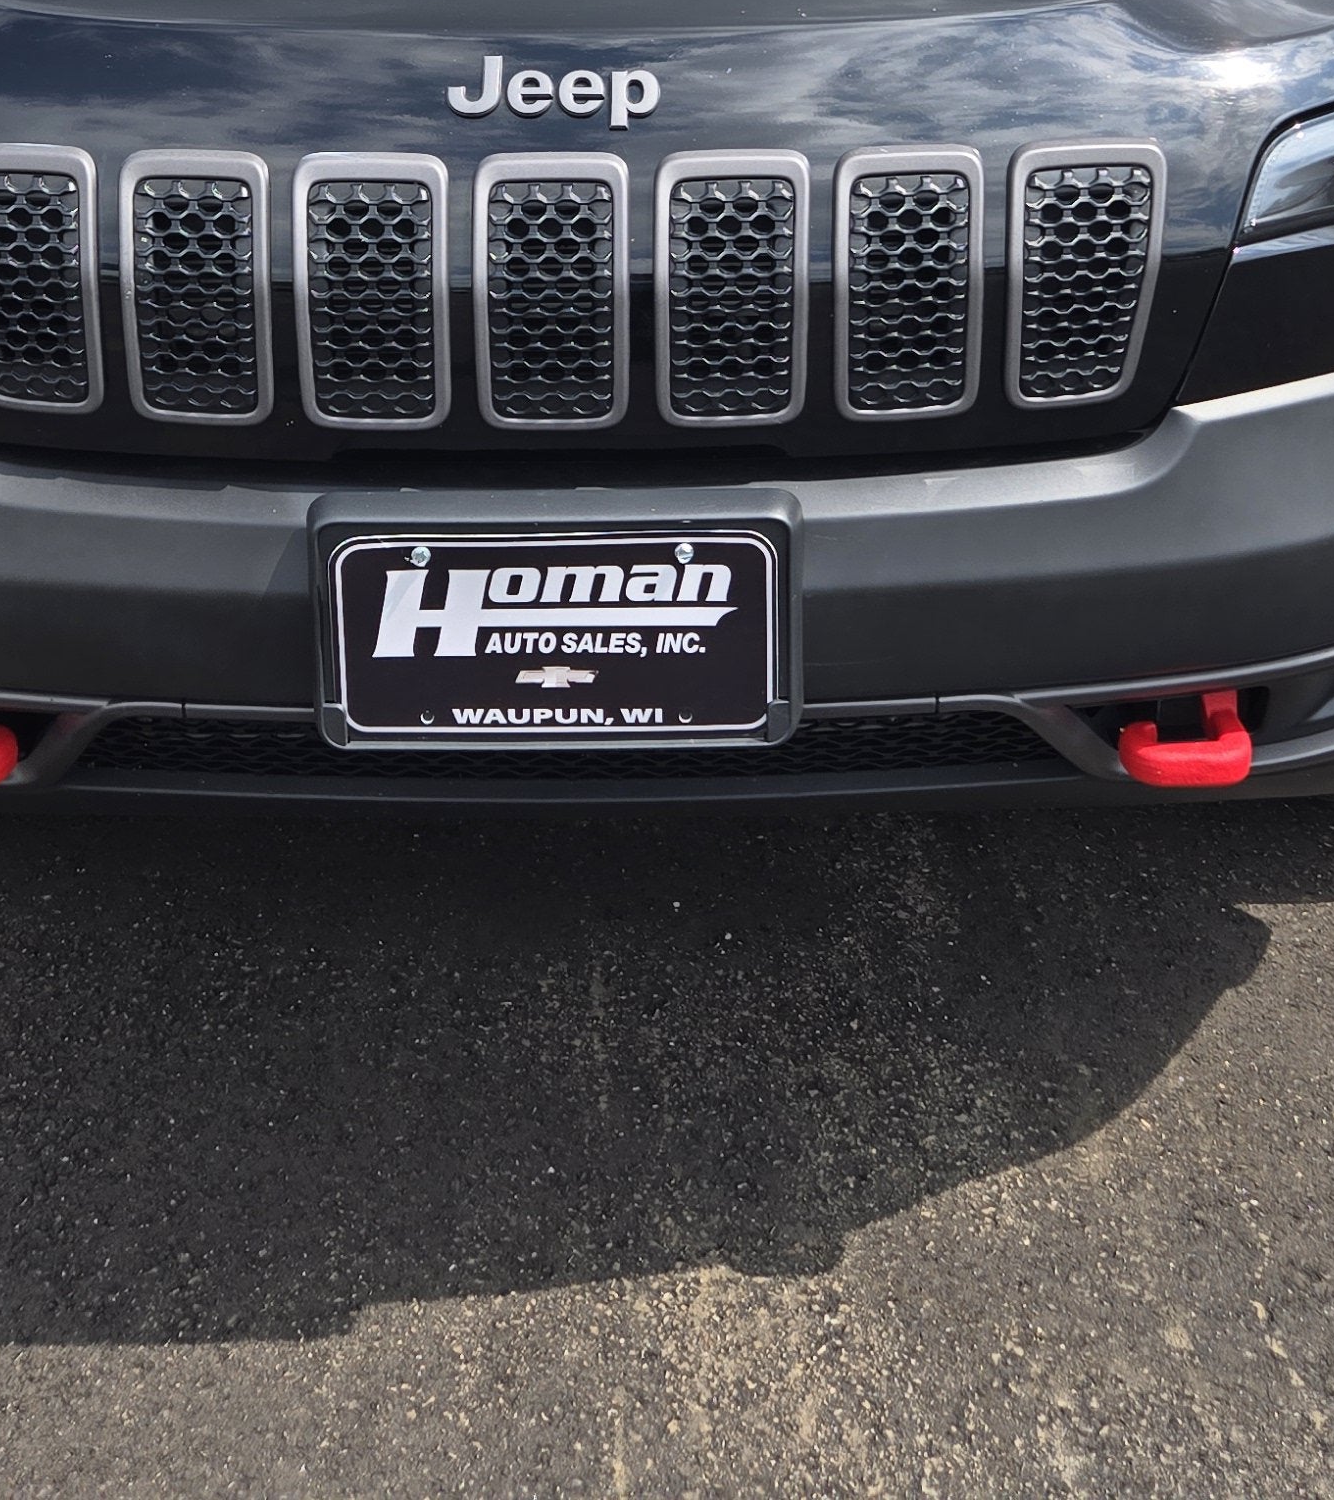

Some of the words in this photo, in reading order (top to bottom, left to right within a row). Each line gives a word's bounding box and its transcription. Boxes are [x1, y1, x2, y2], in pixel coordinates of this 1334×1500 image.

[447, 55, 661, 131] Jeep
[372, 563, 734, 658] Homan
[484, 632, 557, 655] AUTO
[561, 632, 648, 658] SALES,
[655, 632, 707, 655] INC.
[452, 707, 614, 727] WAUPUN,
[620, 707, 665, 724] WI
